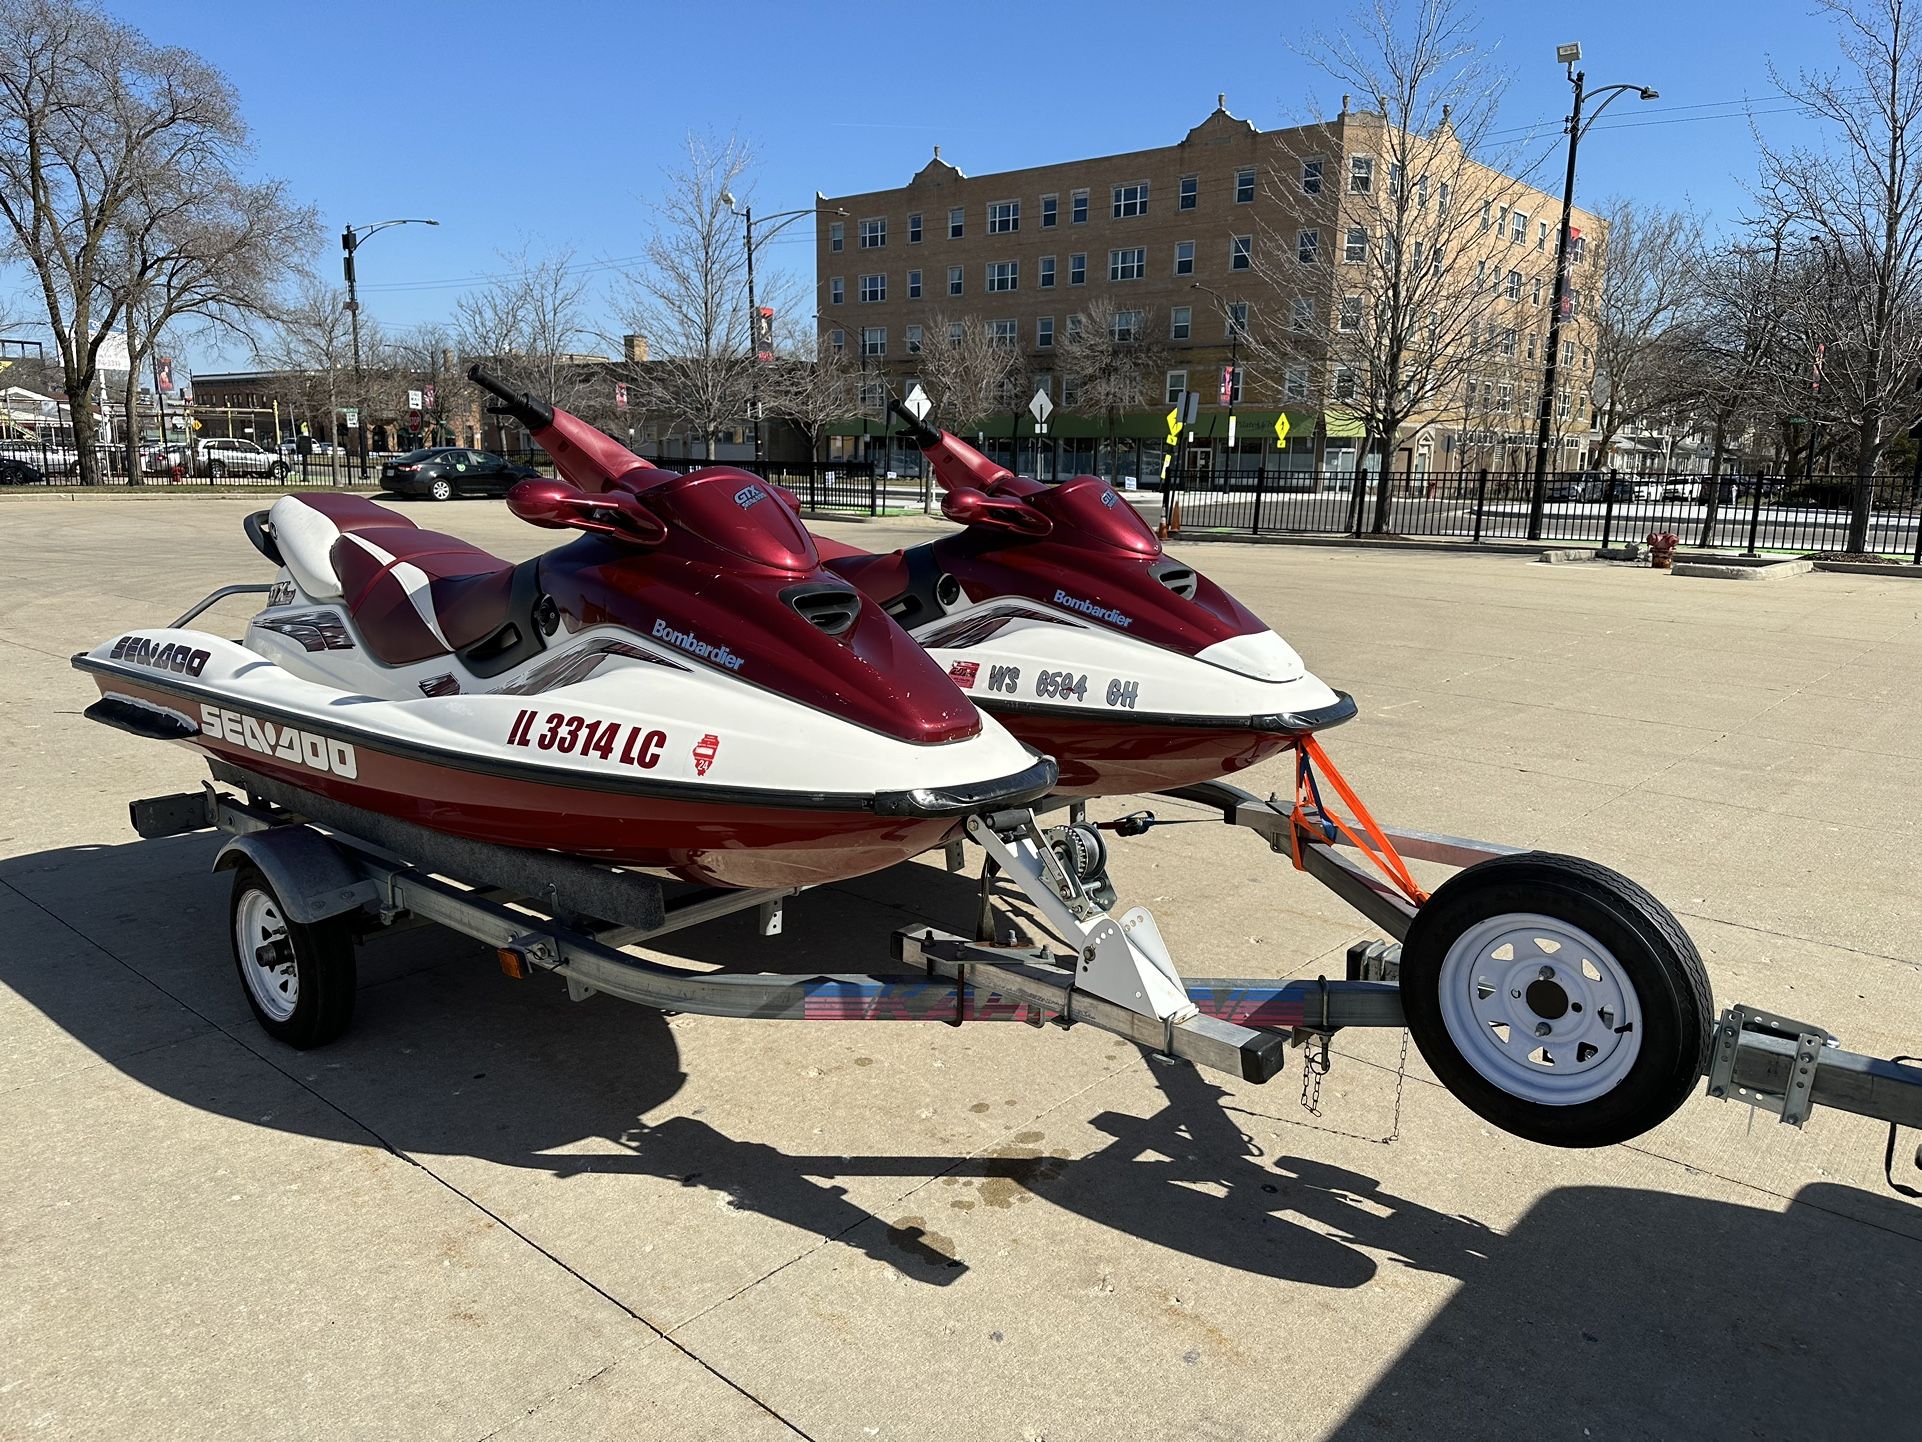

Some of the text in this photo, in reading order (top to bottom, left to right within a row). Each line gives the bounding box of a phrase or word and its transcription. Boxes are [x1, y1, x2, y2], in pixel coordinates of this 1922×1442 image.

[734, 485, 759, 504] GTX
[1054, 589, 1133, 627] Bombardier
[652, 618, 745, 671] Bombardier
[988, 664, 1140, 709] WS 6594 GH
[507, 709, 667, 770] IL 3314 LC
[697, 760, 709, 771] 24
